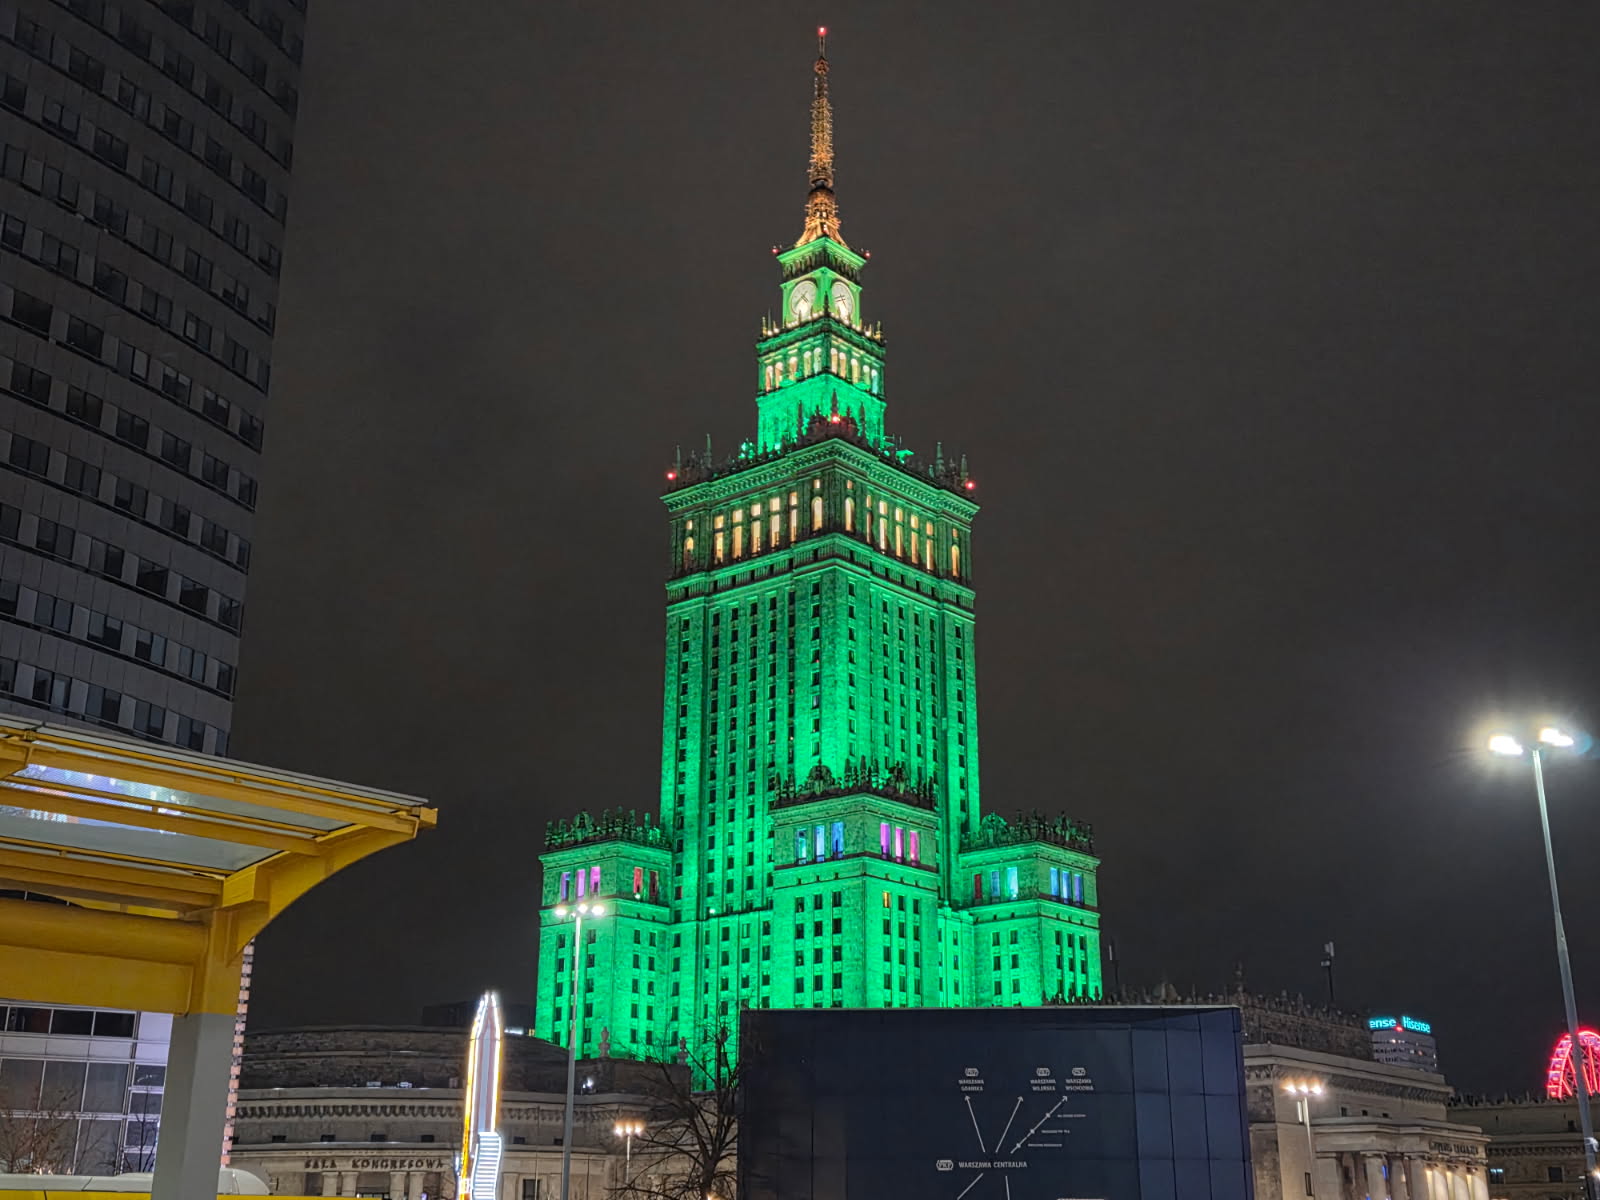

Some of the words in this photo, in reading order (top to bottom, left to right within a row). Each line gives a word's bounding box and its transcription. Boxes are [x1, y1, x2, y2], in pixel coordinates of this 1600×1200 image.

[1369, 1018, 1397, 1029] ense
[1402, 1016, 1431, 1034] Hisense
[304, 1159, 337, 1169] SALA
[352, 1158, 444, 1169] KONGRESOWA
[958, 1161, 992, 1169] WARSZAWA
[993, 1161, 1028, 1169] CENTRALNA
